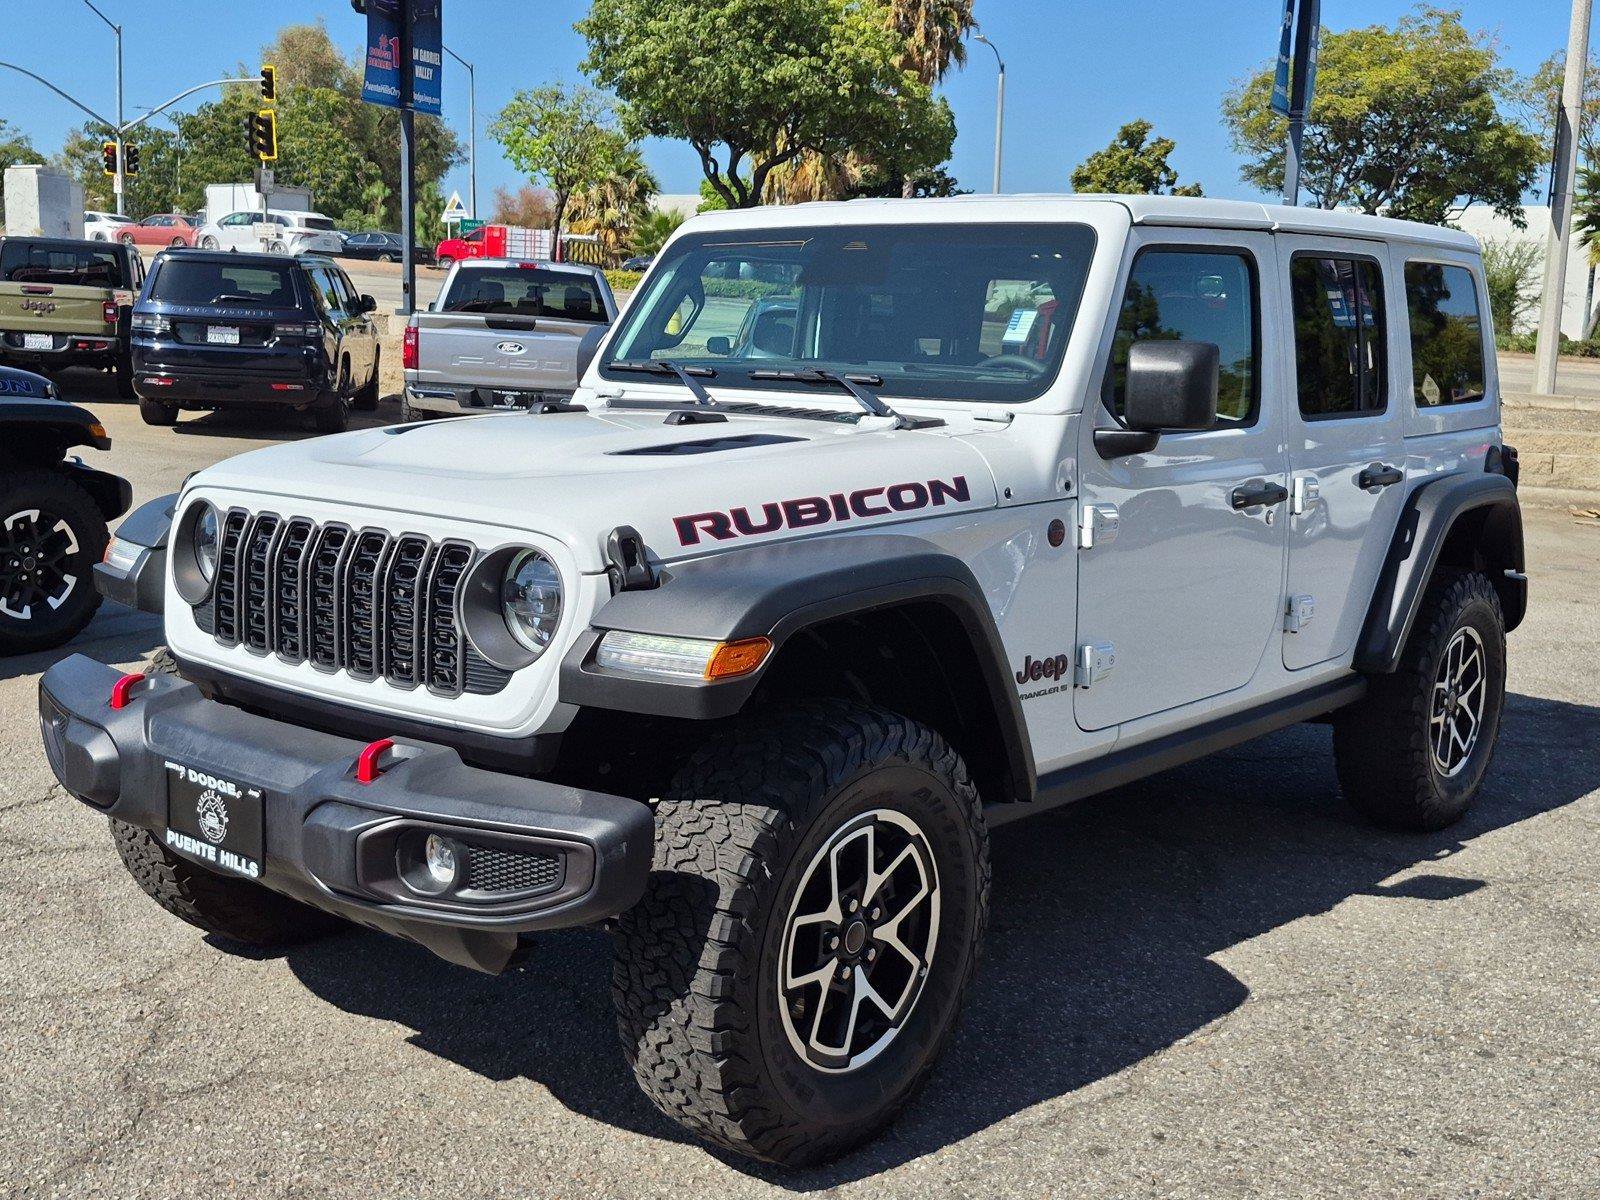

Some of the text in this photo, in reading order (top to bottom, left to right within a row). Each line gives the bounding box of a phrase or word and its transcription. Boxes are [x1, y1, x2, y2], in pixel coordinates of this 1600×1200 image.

[414, 65, 434, 80] VALLEY
[20, 299, 56, 314] Jeep
[452, 356, 569, 372] F-150
[672, 475, 971, 547] RUBICON
[1016, 654, 1068, 684] Jeep
[1018, 686, 1059, 701] RANGLER
[188, 769, 236, 797] DODGE
[166, 828, 216, 862] PUENTE
[220, 849, 259, 878] HILLS
